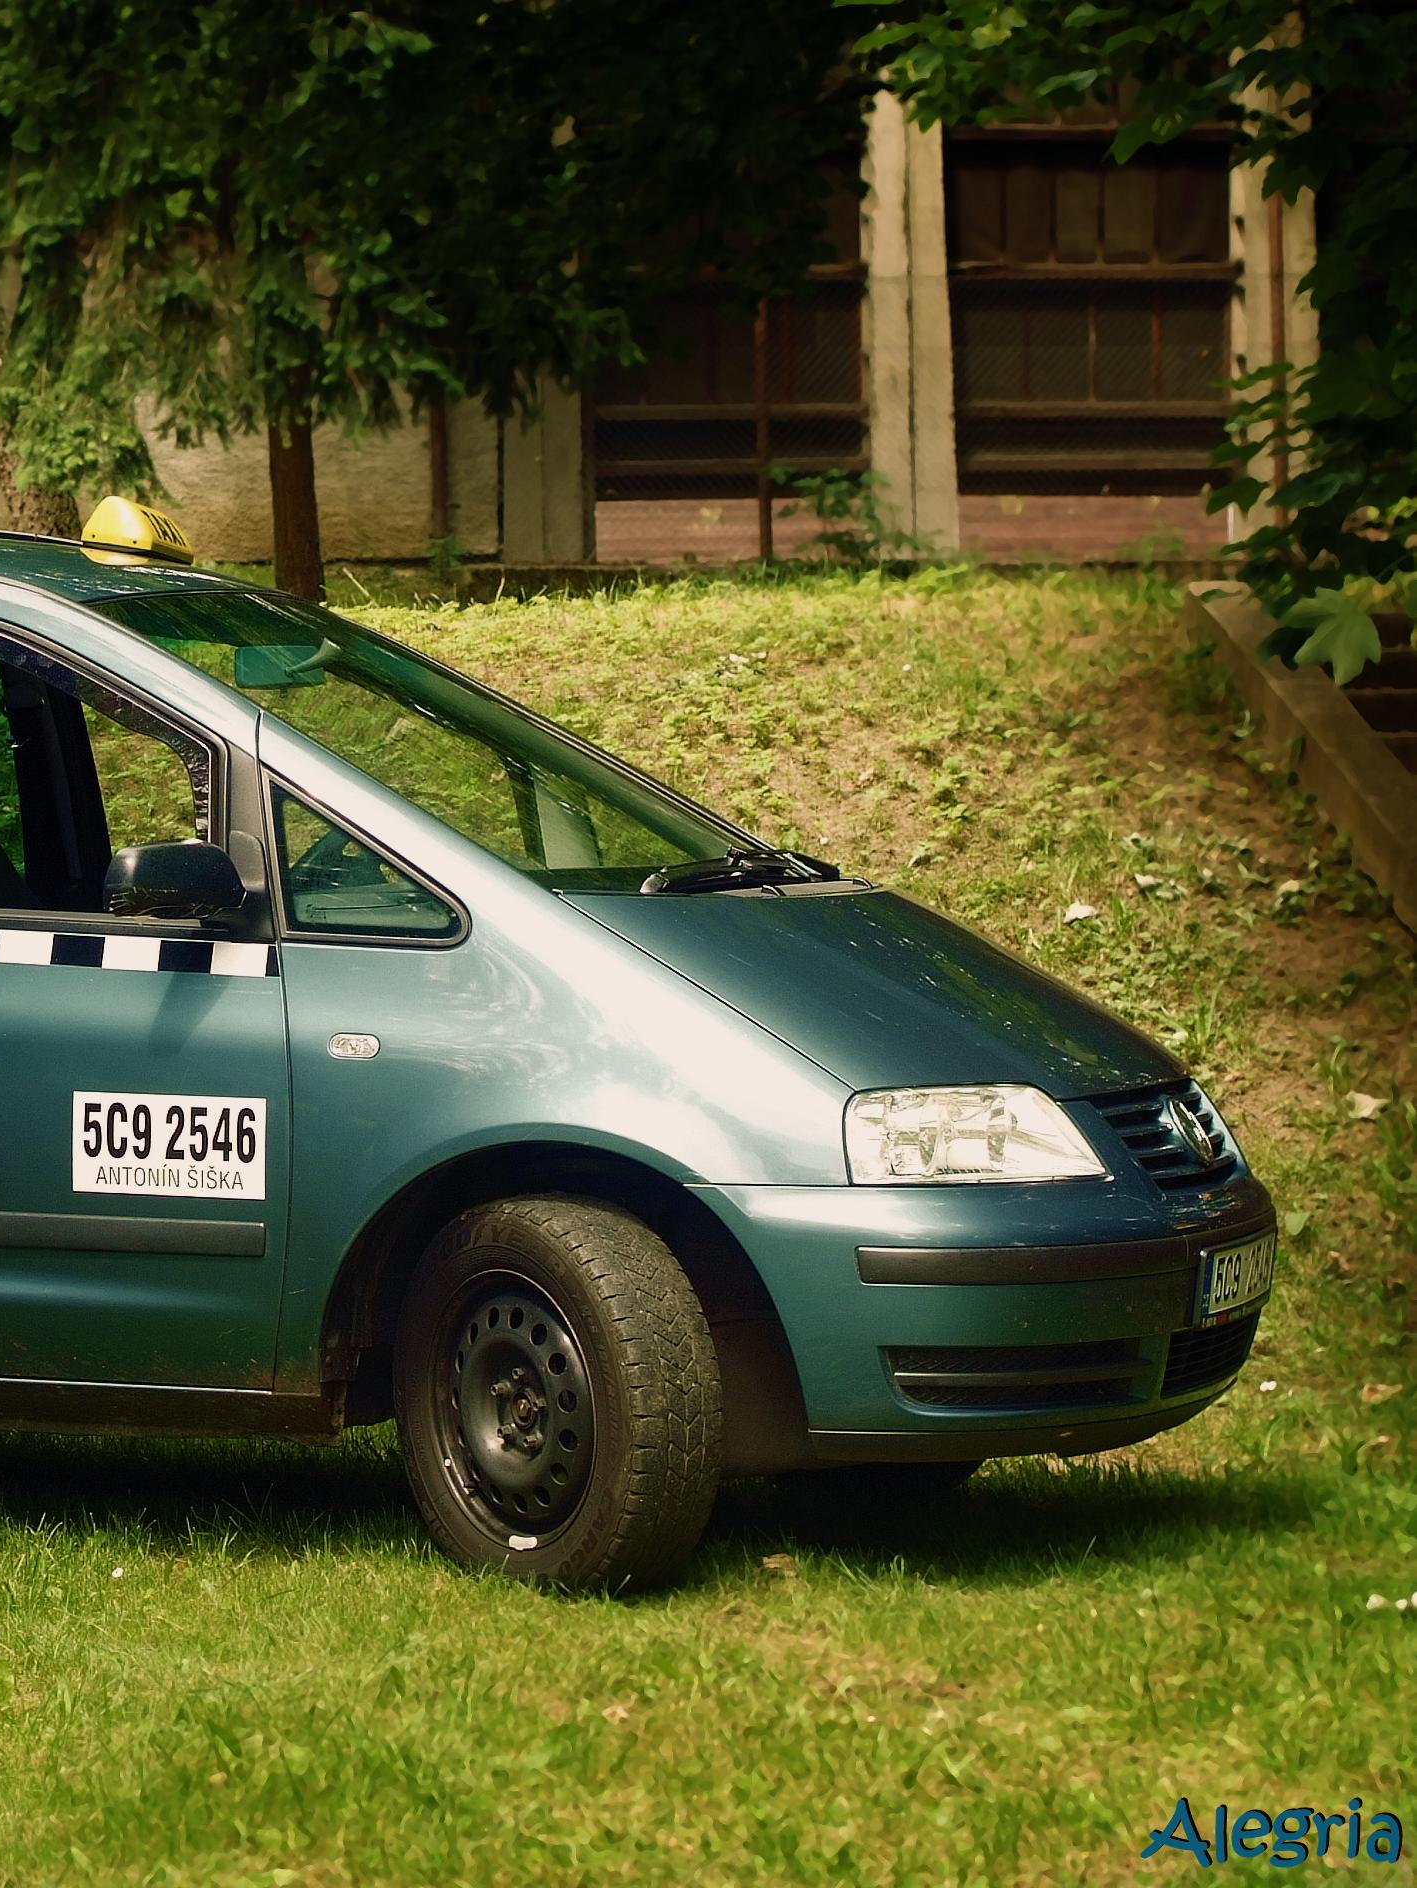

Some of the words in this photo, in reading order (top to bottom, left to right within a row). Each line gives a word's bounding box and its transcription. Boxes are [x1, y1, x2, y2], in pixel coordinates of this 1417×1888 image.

[140, 509, 188, 548] TAXI
[83, 1102, 152, 1160] 5C9
[165, 1105, 256, 1164] 2546
[95, 1164, 180, 1188] ANTONÍN
[187, 1165, 244, 1190] ŠIŠKA
[1213, 1253, 1242, 1304] 5C9
